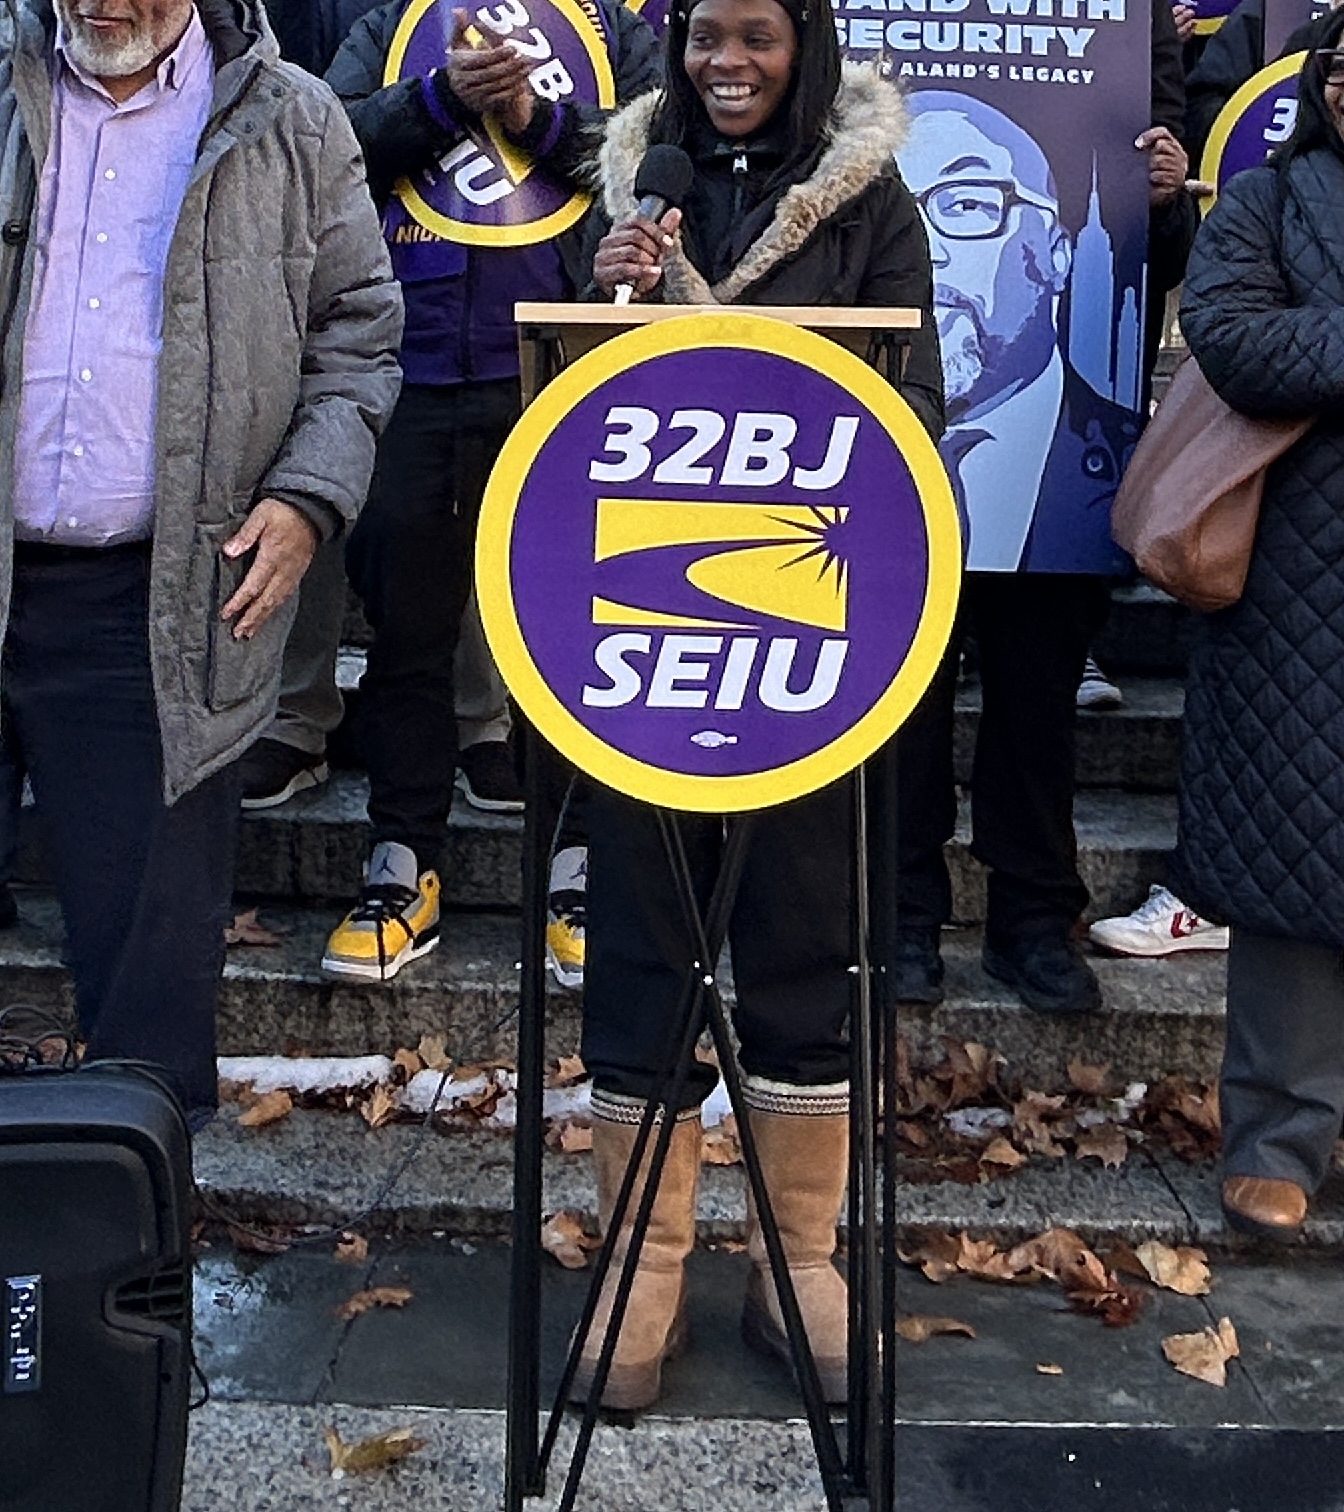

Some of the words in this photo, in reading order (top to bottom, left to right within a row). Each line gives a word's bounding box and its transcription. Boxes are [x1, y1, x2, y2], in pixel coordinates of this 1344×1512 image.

[900, 61, 1001, 79] ALAND'S
[1009, 65, 1094, 84] LEGACY
[438, 139, 516, 206] IU
[588, 406, 860, 490] 32BJ
[582, 632, 850, 712] SEIU
